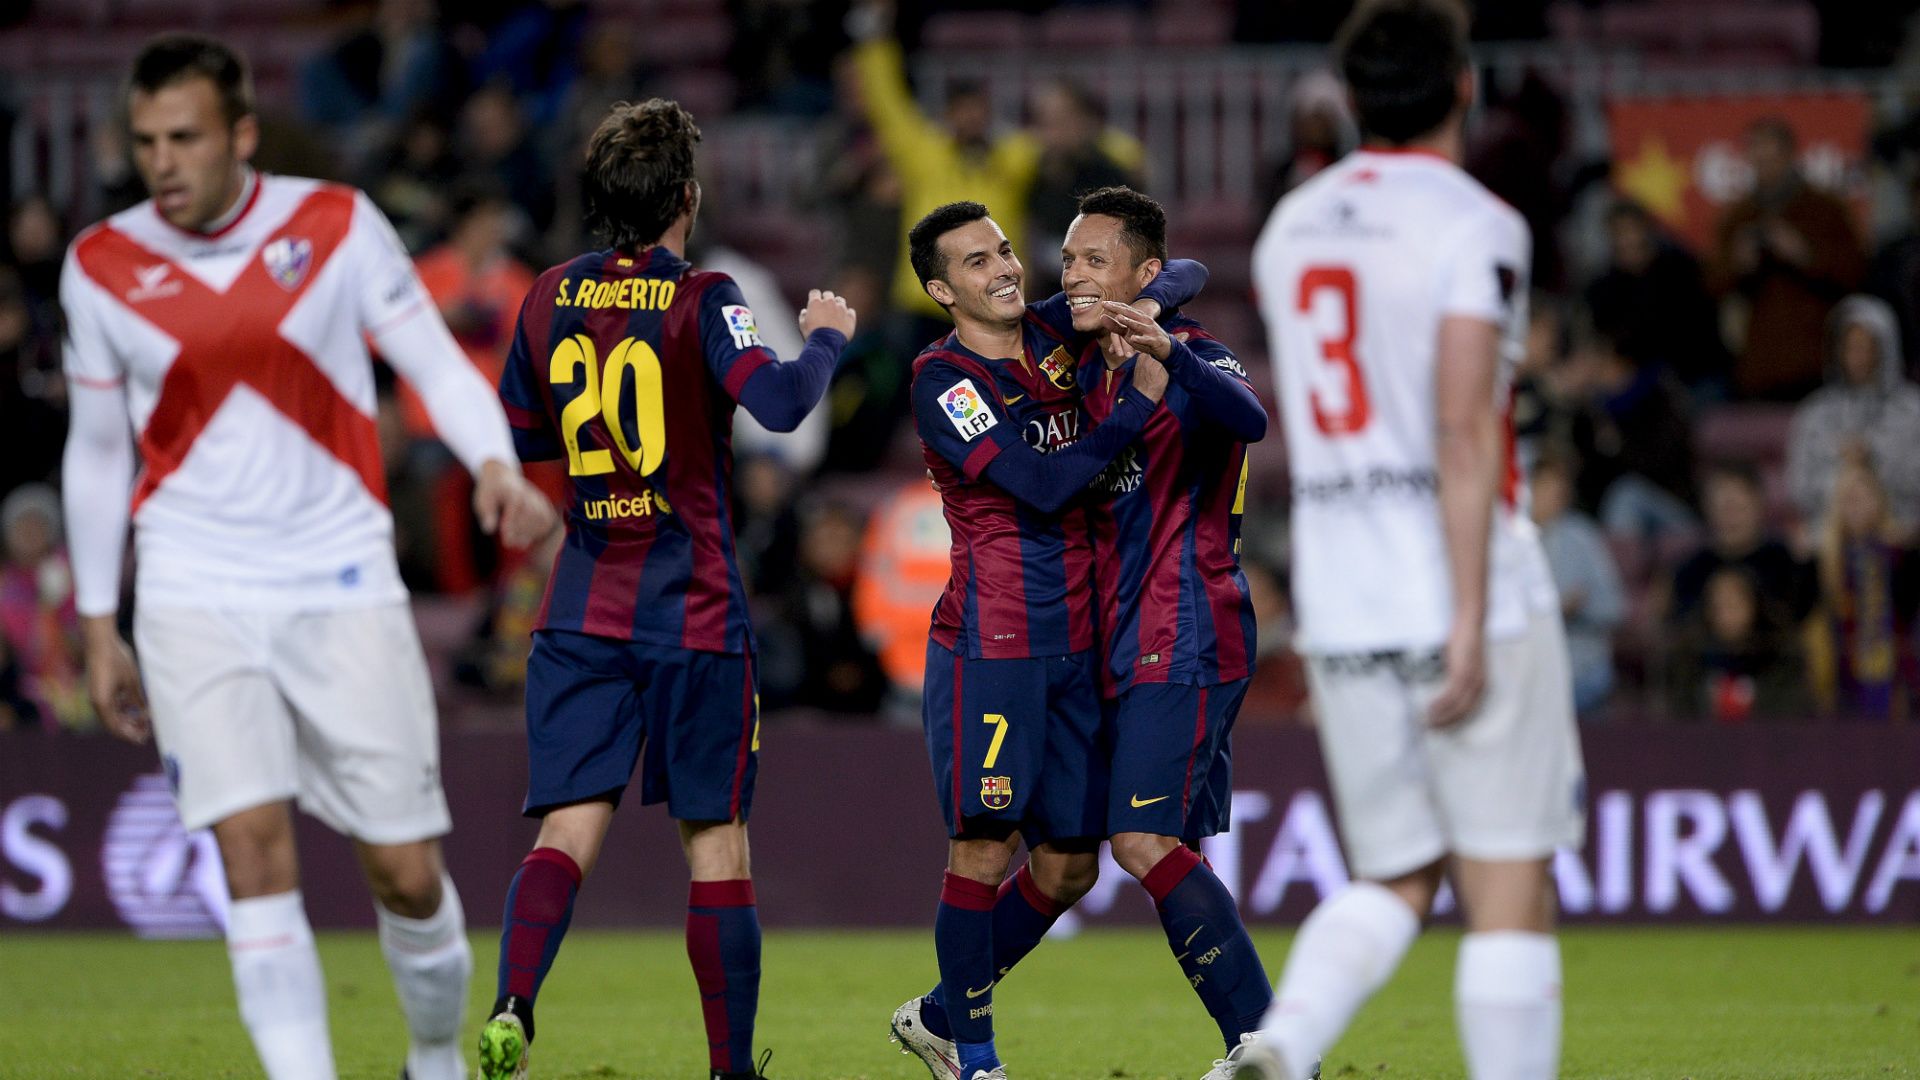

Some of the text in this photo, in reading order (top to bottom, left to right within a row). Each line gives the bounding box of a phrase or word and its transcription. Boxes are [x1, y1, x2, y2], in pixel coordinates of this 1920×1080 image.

[555, 278, 676, 311] S. ROBERTO
[1208, 356, 1247, 377] eko
[1294, 265, 1372, 438] 3
[550, 333, 665, 478] 20
[962, 412, 989, 438] LFP
[584, 489, 652, 520] unicef
[982, 713, 1009, 769] 7
